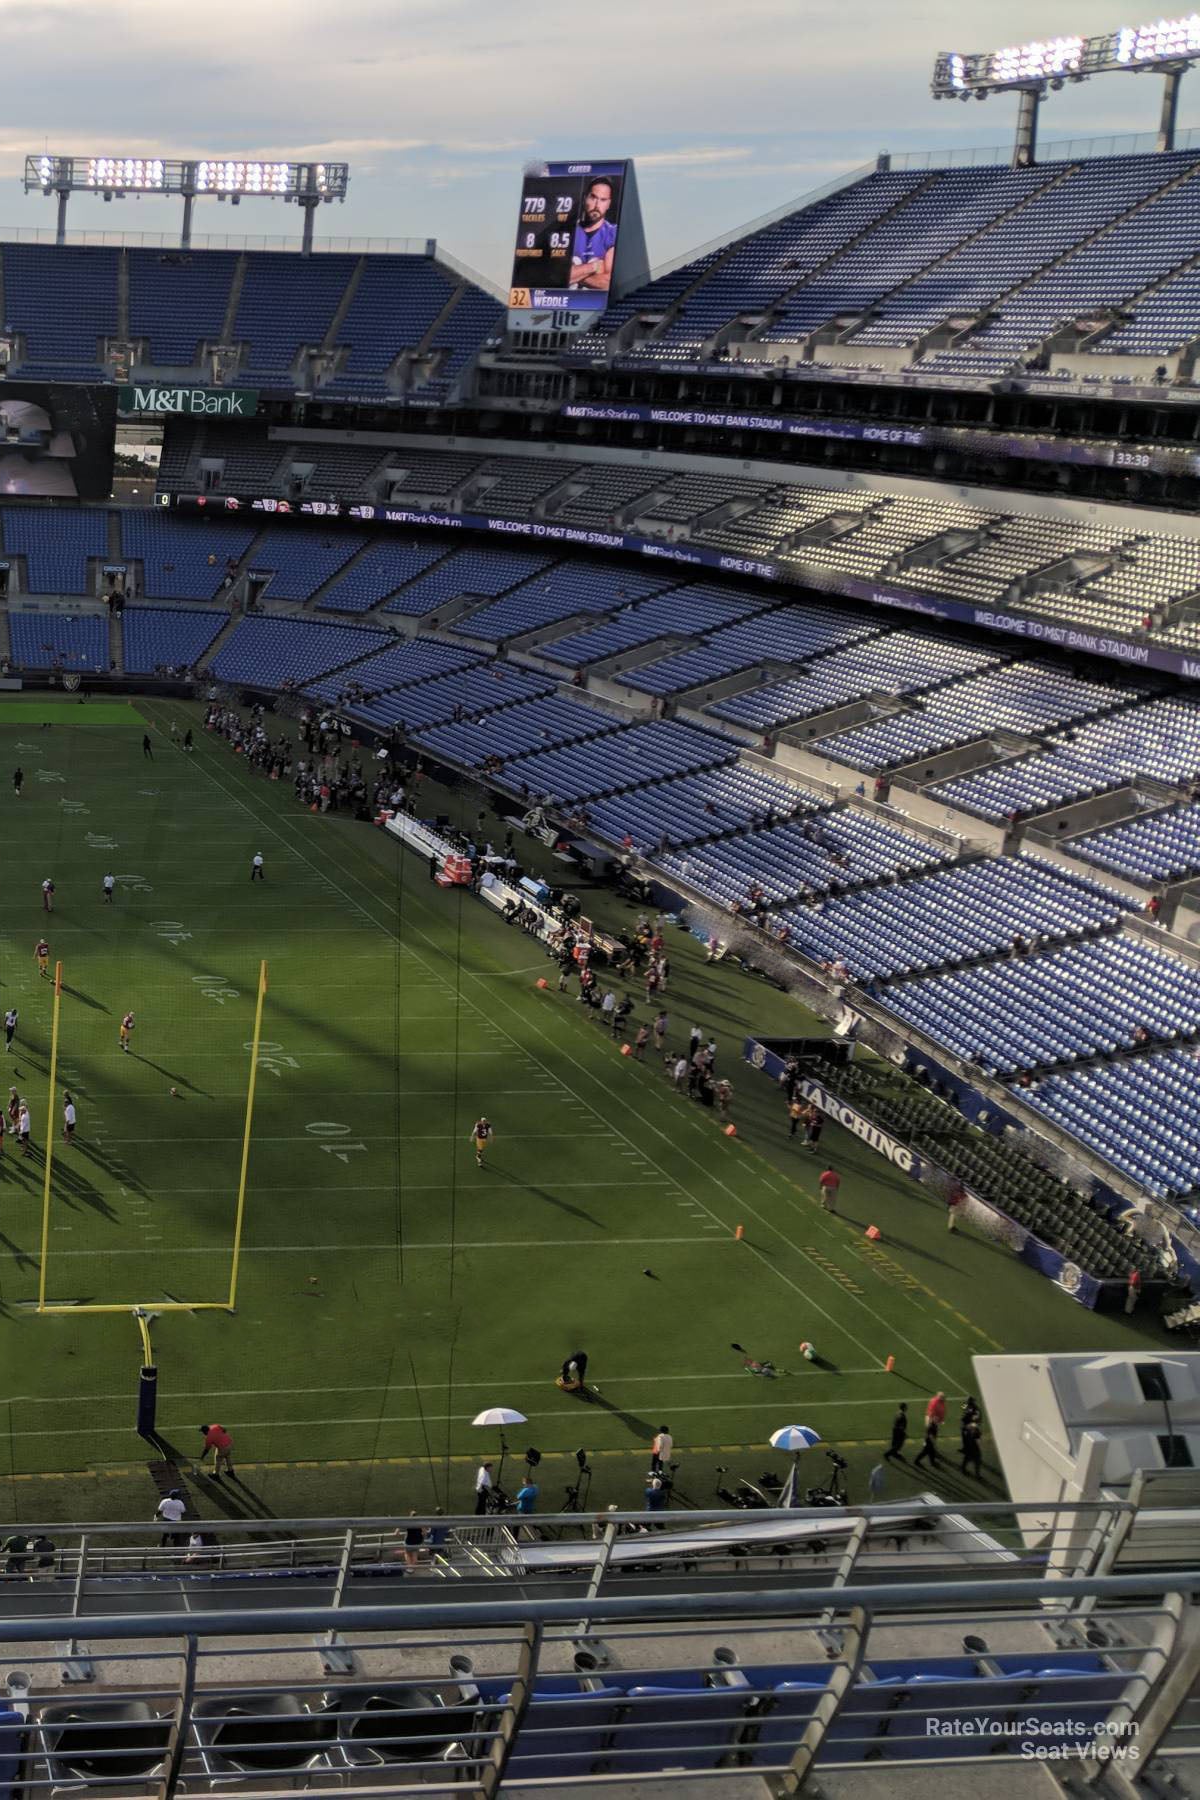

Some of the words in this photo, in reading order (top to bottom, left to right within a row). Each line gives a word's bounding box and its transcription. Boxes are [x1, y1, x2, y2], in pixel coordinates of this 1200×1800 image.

[524, 197, 547, 213] 779
[556, 196, 573, 212] 29
[526, 233, 535, 248] 8
[550, 233, 571, 248] 8.5
[512, 290, 525, 306] 32
[549, 310, 581, 329] Lite
[133, 387, 190, 412] M&T
[191, 390, 244, 415] Bank
[651, 410, 693, 424] WELCOME
[693, 413, 706, 424] TO
[706, 414, 725, 425] M&T
[726, 415, 749, 427] BANK
[749, 417, 783, 430] STADIUM
[862, 428, 889, 440] HOME
[889, 431, 903, 442] OF
[903, 432, 922, 444] THE
[1116, 452, 1150, 466] 33:38
[161, 494, 169, 505] 0
[488, 519, 531, 534] WELCOME
[533, 523, 545, 536] TO
[546, 525, 565, 538] M&T
[566, 528, 588, 541] BANK
[588, 530, 623, 546] STADIUM
[720, 556, 743, 571] HOME
[743, 560, 756, 573] OF
[756, 564, 773, 577] THE
[974, 610, 1027, 634] WELCOME
[1027, 622, 1043, 637] TO
[1043, 626, 1067, 643] M&T
[1068, 631, 1097, 649] BANK
[1098, 638, 1149, 662] STADIUM
